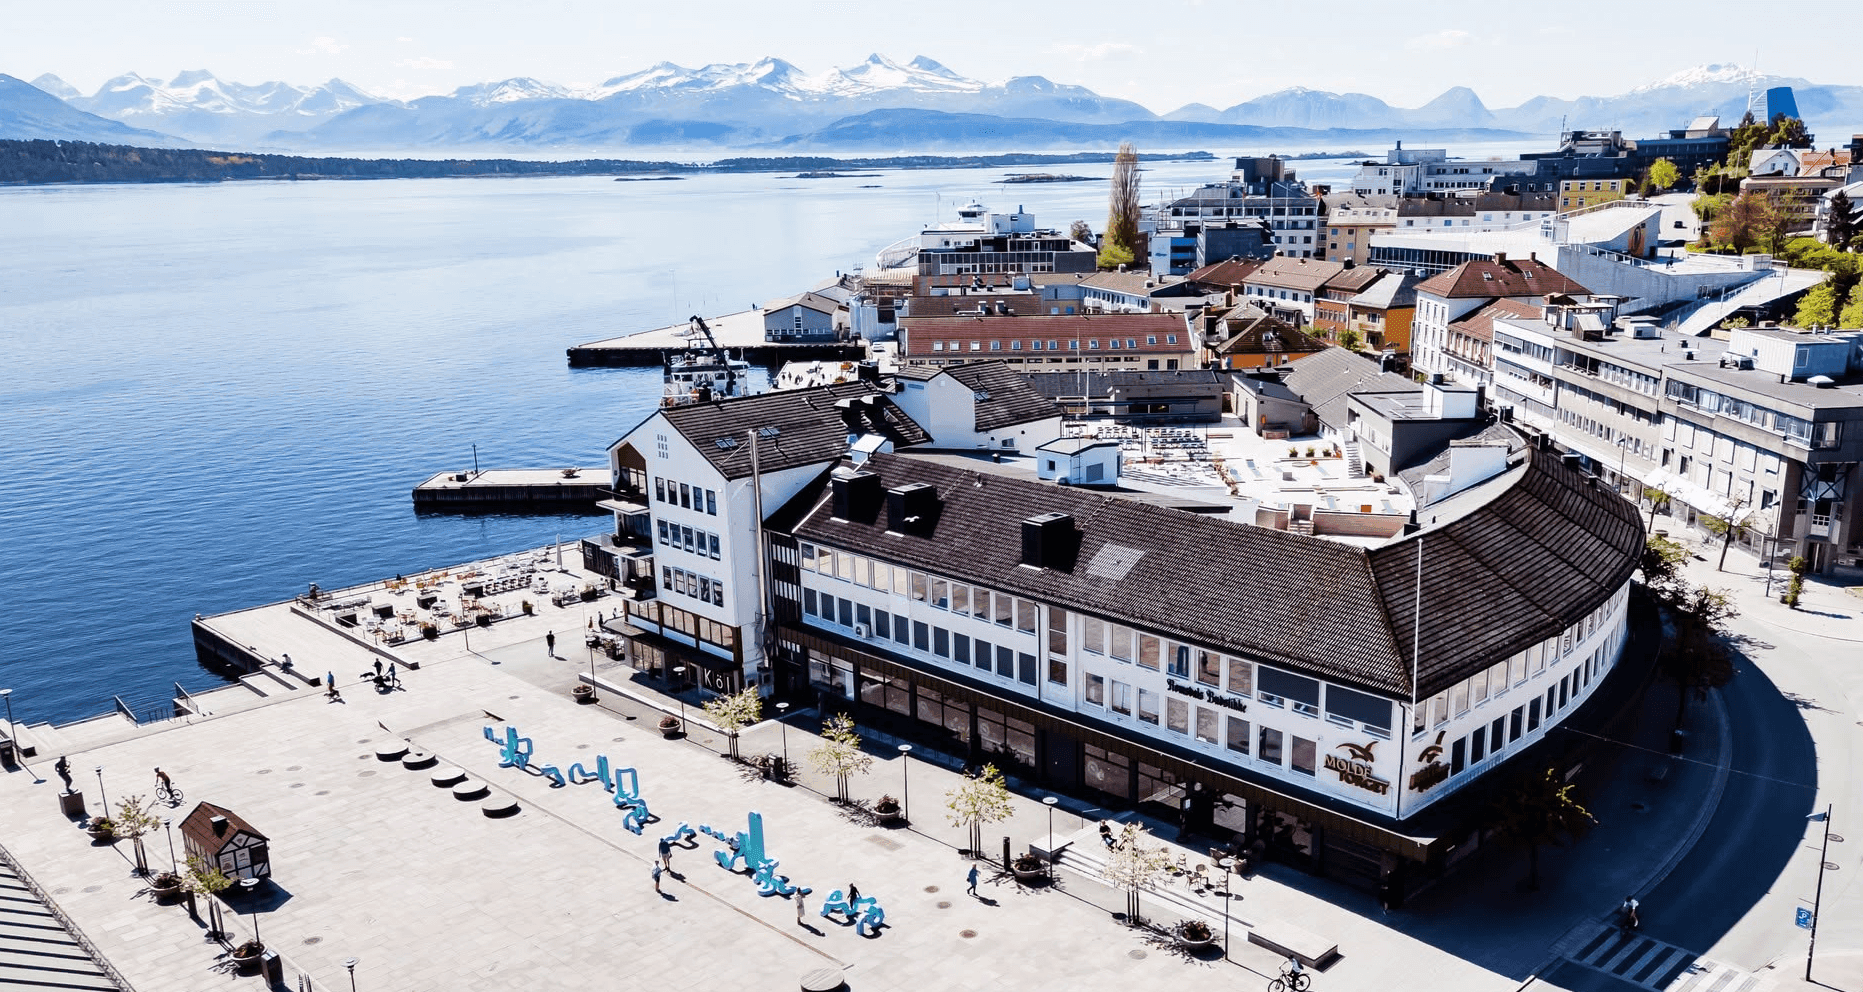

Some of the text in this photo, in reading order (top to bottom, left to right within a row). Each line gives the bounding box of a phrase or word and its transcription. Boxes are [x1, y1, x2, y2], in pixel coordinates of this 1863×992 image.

[704, 668, 730, 694] Köl
[1324, 753, 1373, 777] MOLDE
[1339, 770, 1390, 795] TORGET
